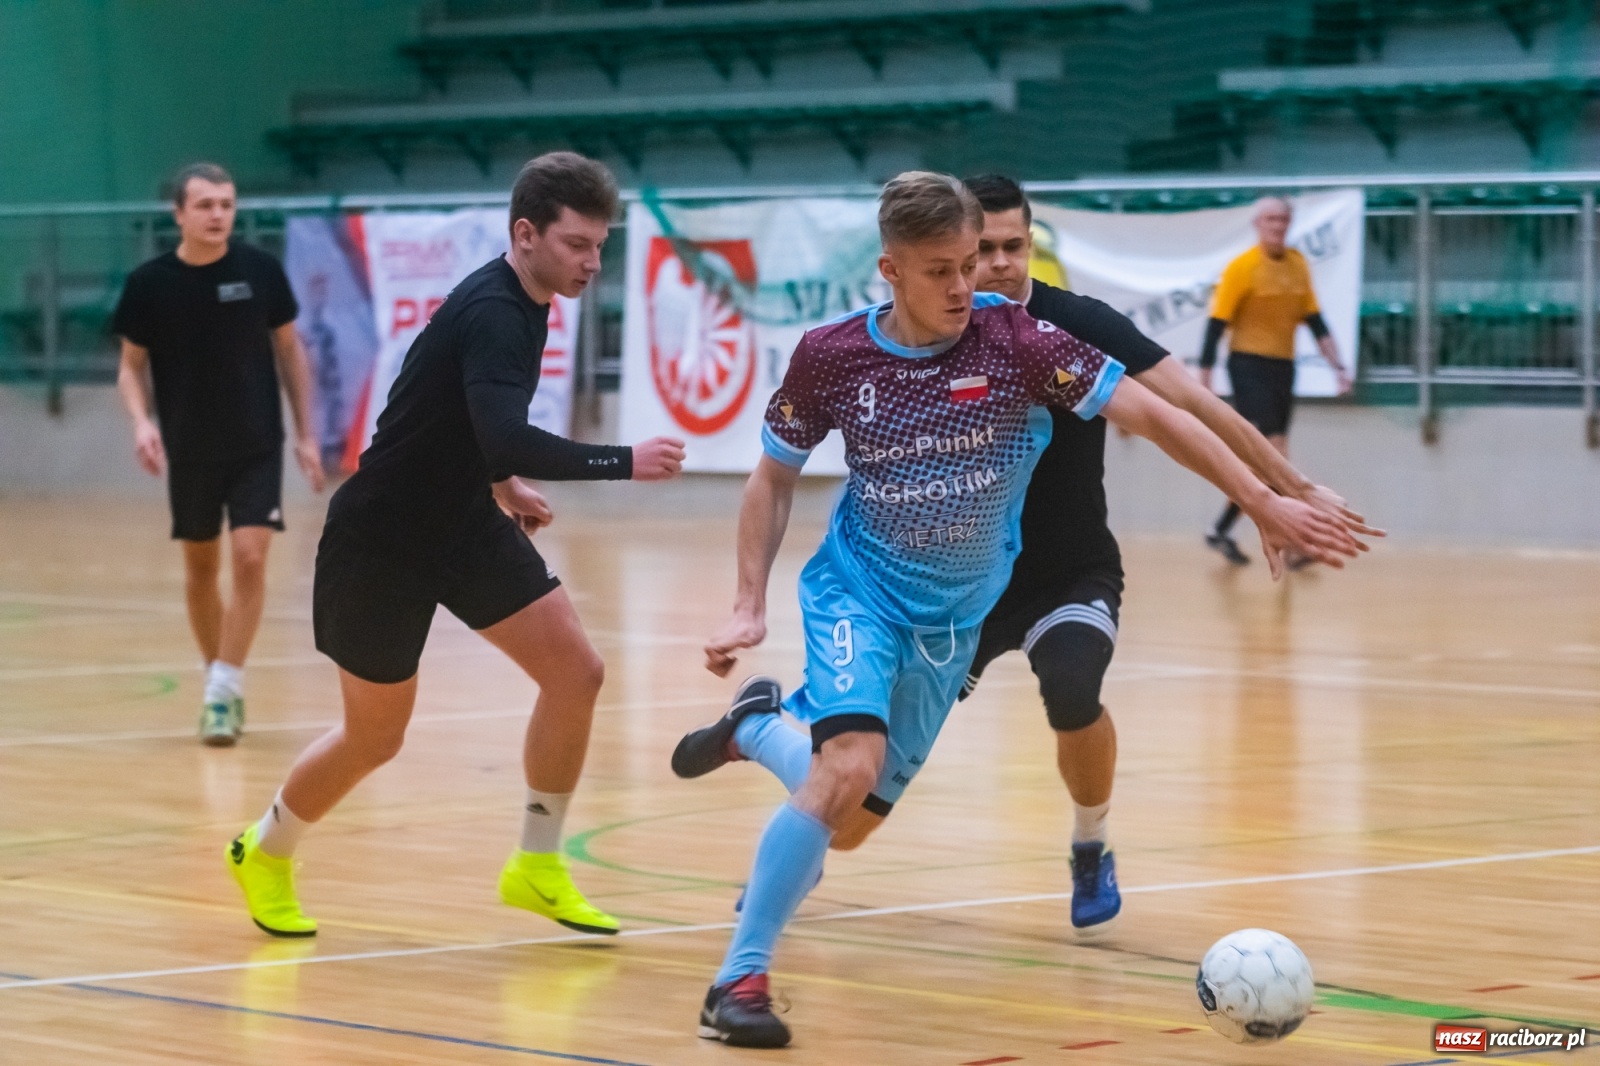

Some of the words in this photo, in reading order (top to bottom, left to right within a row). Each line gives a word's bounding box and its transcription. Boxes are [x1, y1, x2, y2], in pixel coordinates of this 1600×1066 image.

[858, 382, 877, 424] 9
[862, 467, 998, 504] AGROTIM
[890, 517, 979, 548] KIETRZ
[832, 616, 855, 669] 9
